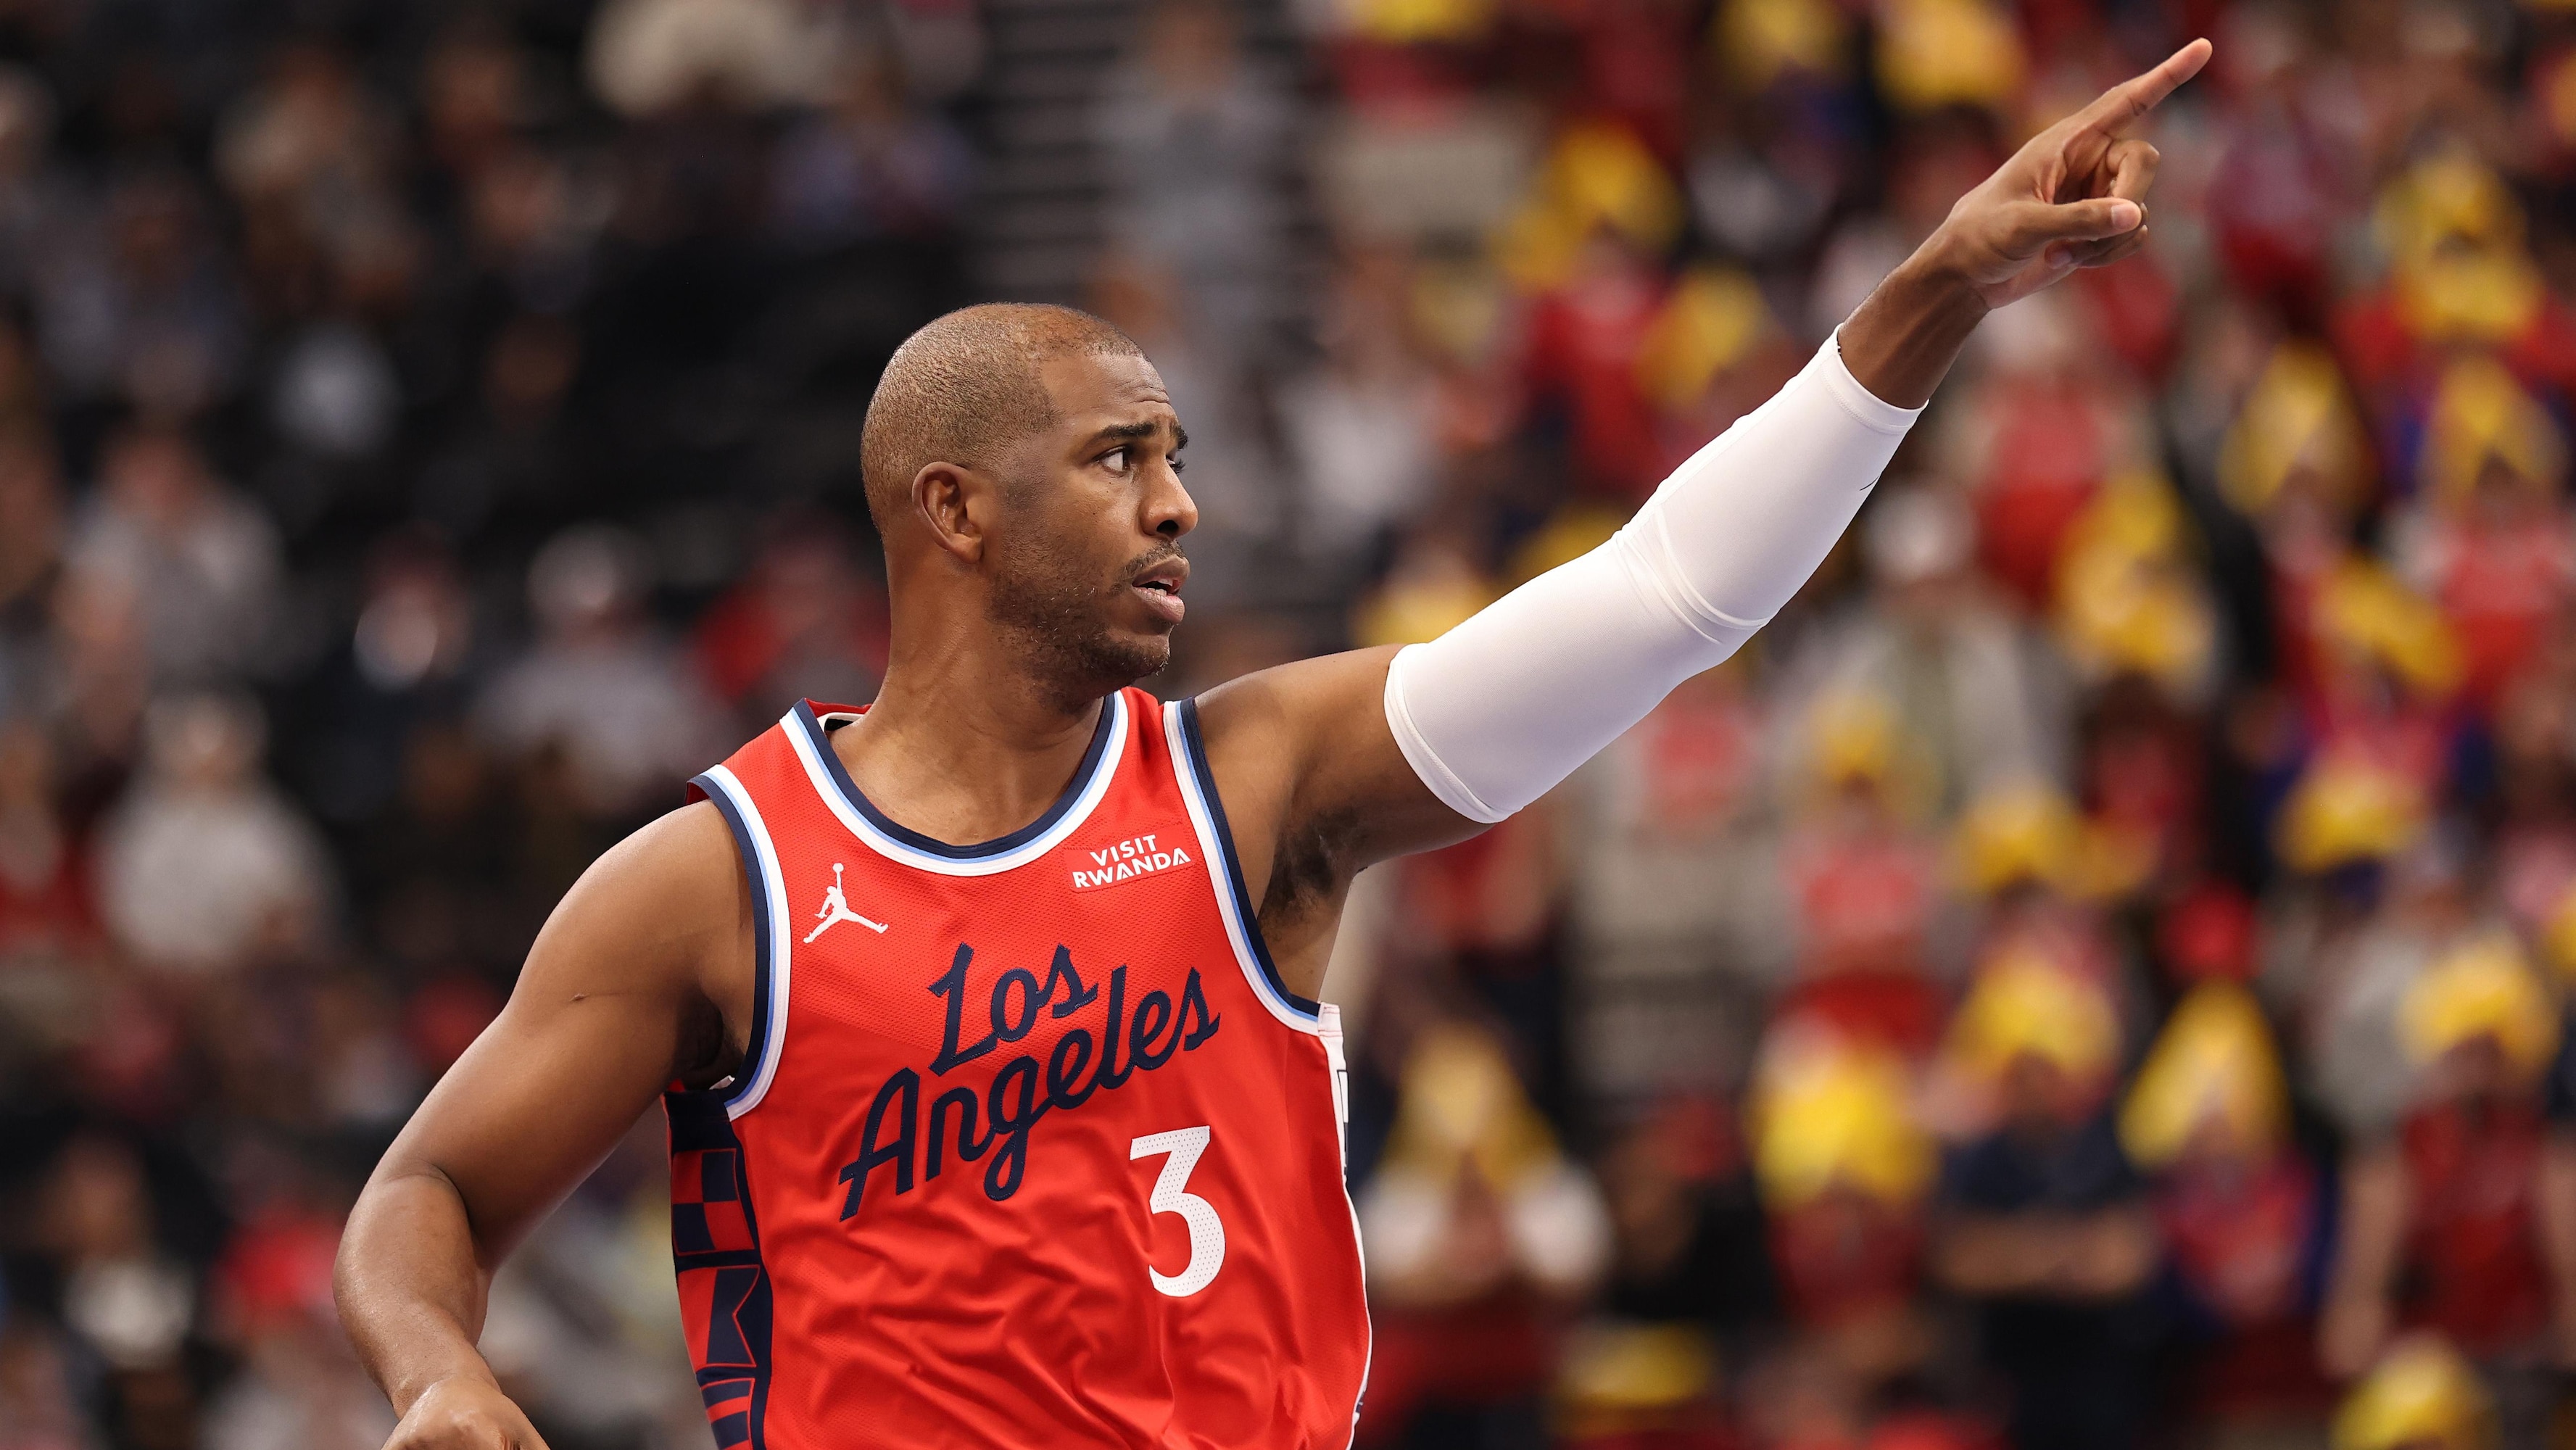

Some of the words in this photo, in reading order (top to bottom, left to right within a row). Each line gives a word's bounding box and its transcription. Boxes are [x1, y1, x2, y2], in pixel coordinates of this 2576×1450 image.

[1072, 847, 1191, 888] RWANDA
[1089, 834, 1156, 866] VISIT
[928, 942, 1098, 1077] Los
[838, 965, 1220, 1222] Angeles
[1130, 1125, 1226, 1298] 3
